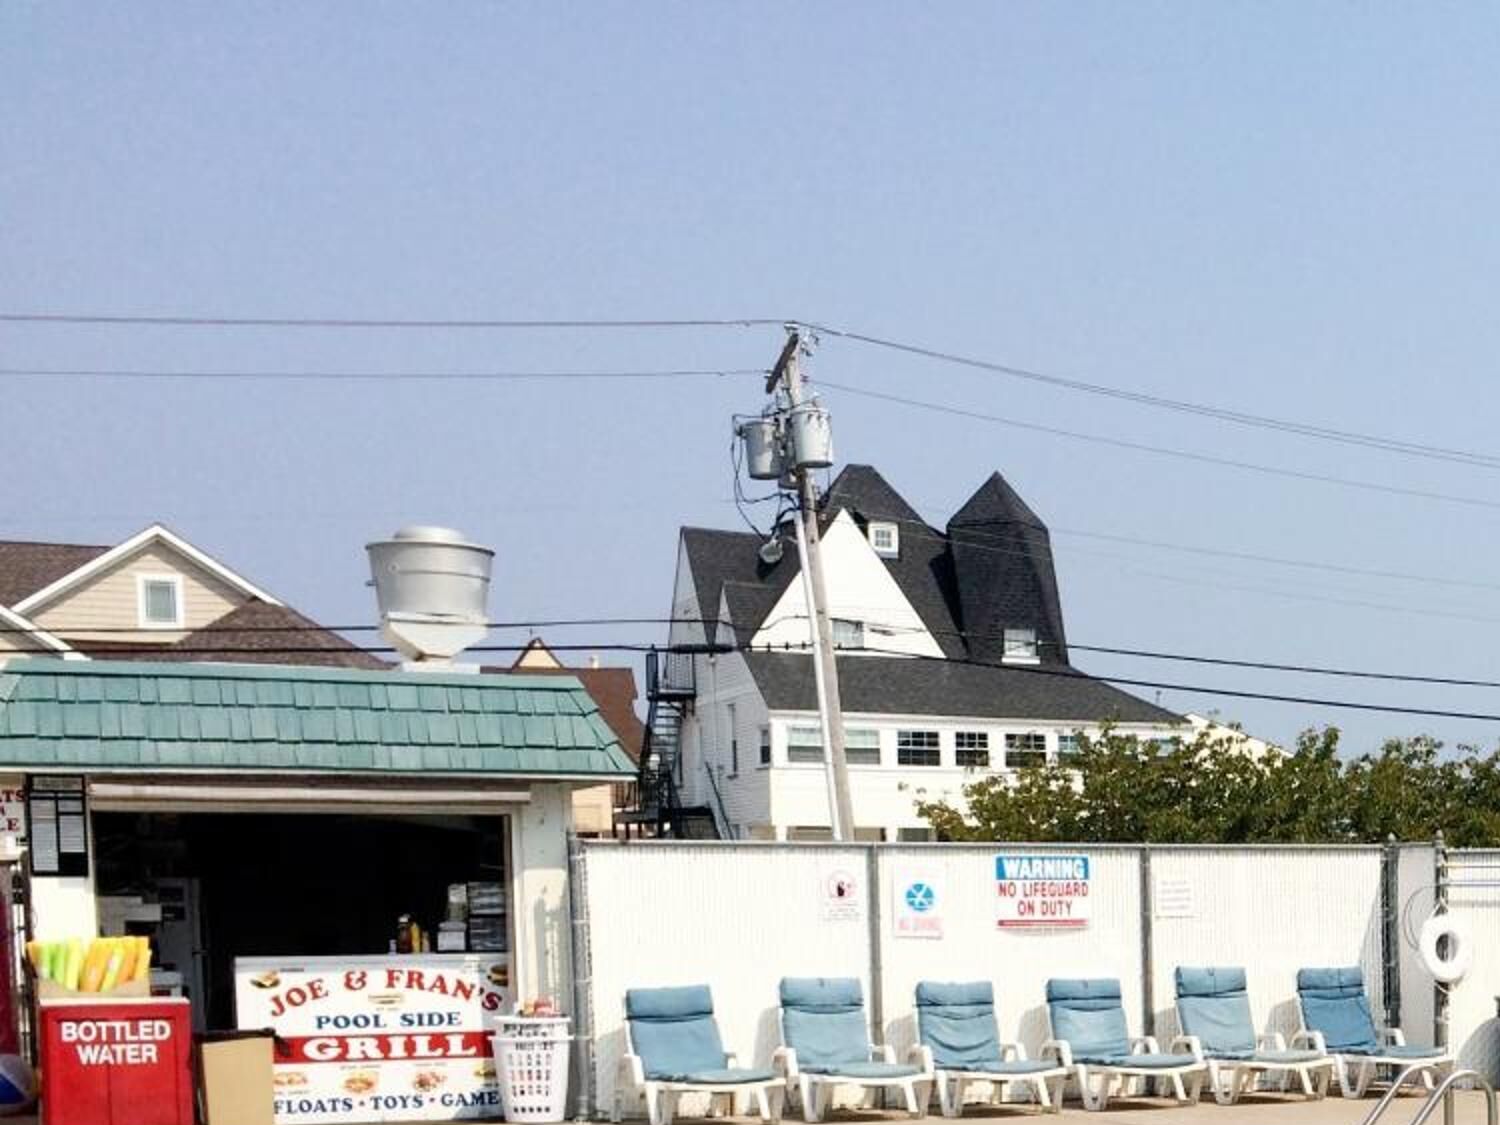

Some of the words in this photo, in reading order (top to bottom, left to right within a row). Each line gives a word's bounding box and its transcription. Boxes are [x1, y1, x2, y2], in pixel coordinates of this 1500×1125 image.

[1004, 858, 1085, 879] WARNING
[998, 882, 1017, 896] NO
[1023, 882, 1088, 897] LIFEGUARD
[1018, 900, 1035, 916] ON
[1041, 900, 1072, 916] DUTY
[270, 978, 329, 1017] JOE
[344, 970, 368, 991] &
[385, 969, 503, 1012] FRAN'S
[61, 1020, 171, 1042] BOTTLED
[316, 1013, 387, 1030] POOL
[400, 1011, 461, 1027] SIDE
[76, 1043, 158, 1065] WATER
[302, 1035, 477, 1060] GRILL
[273, 1097, 354, 1115] FLOATS
[369, 1094, 424, 1110] TOYS
[441, 1090, 502, 1107] GAME
